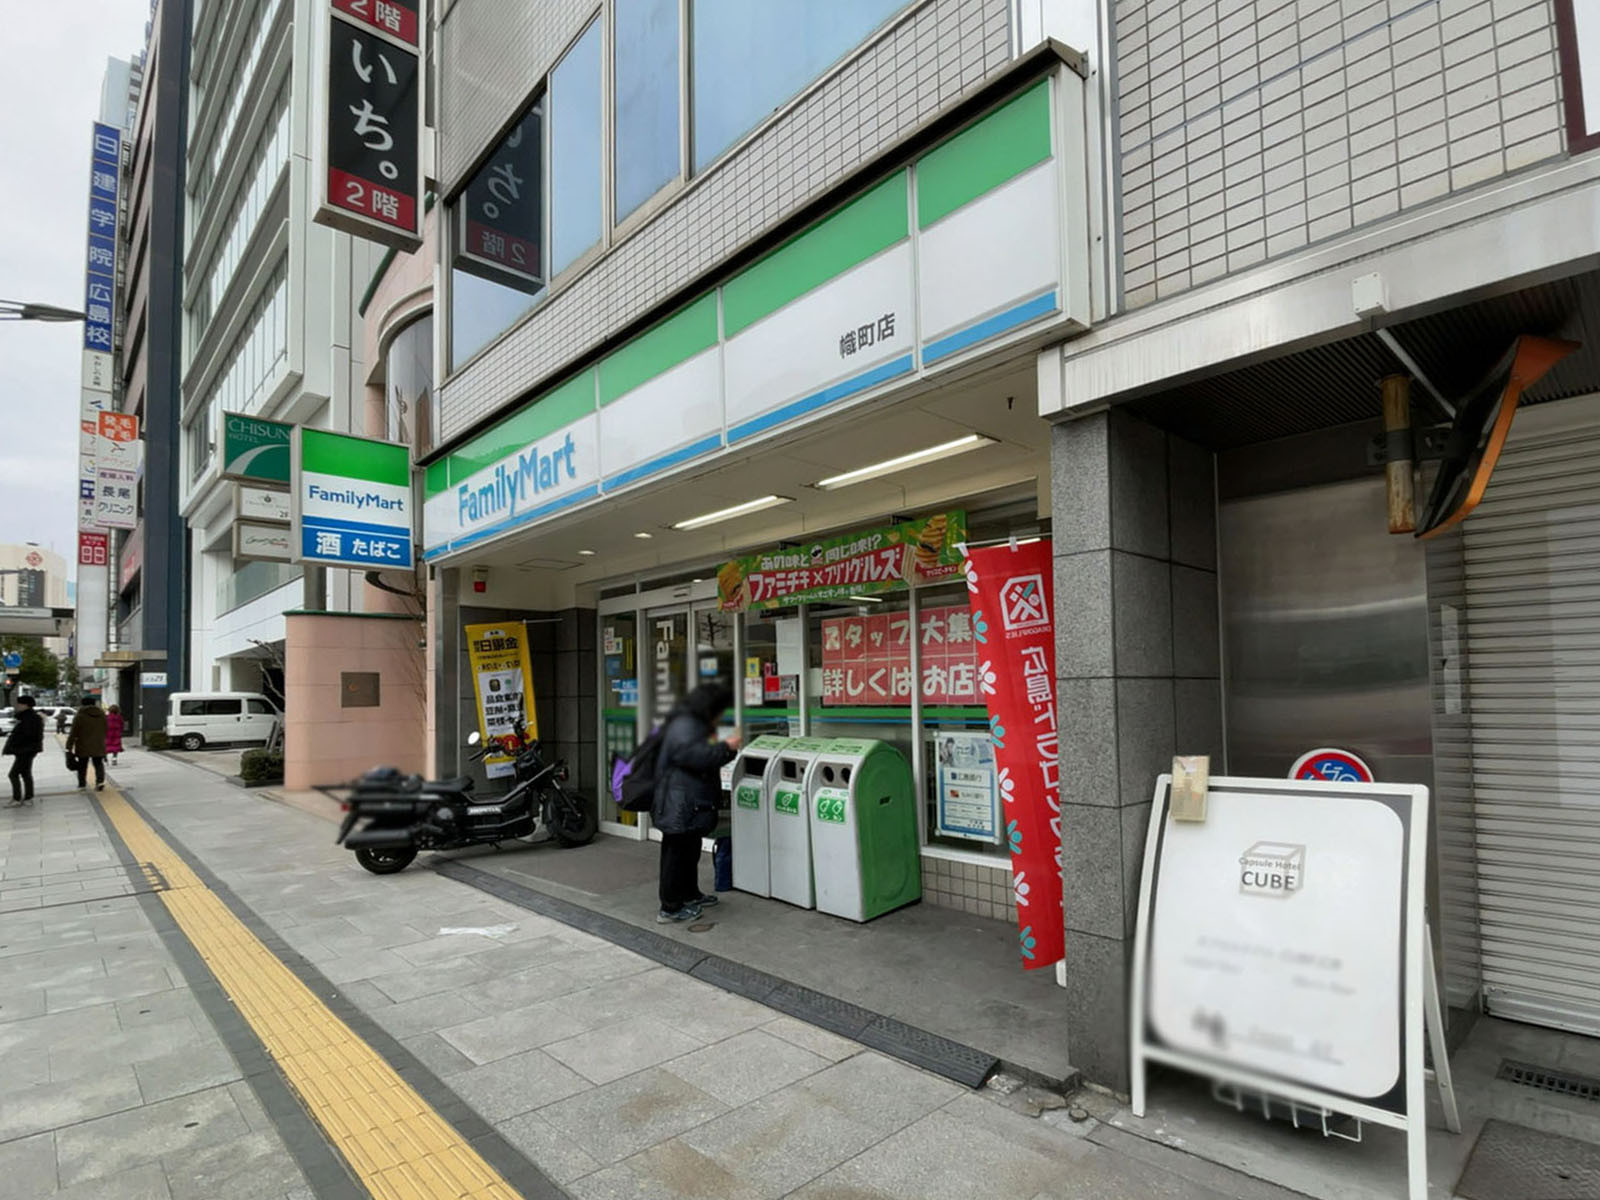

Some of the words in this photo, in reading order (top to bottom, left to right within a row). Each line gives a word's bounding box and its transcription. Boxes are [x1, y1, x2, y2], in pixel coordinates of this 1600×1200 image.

[350, 38, 399, 181] いち。
[346, 181, 399, 221] 2階
[86, 133, 119, 346] 日建学院広島校
[839, 312, 896, 360] 幟町店
[228, 418, 290, 441] CHISUN
[103, 485, 131, 500] 長尾
[458, 431, 577, 528] FamilyMart
[98, 501, 134, 516] クリニック
[308, 484, 404, 512] FamilyMart
[315, 531, 342, 557] 酒
[351, 537, 402, 560] たばこ
[1238, 856, 1273, 868] Capsule
[1241, 870, 1296, 892] CUBE
